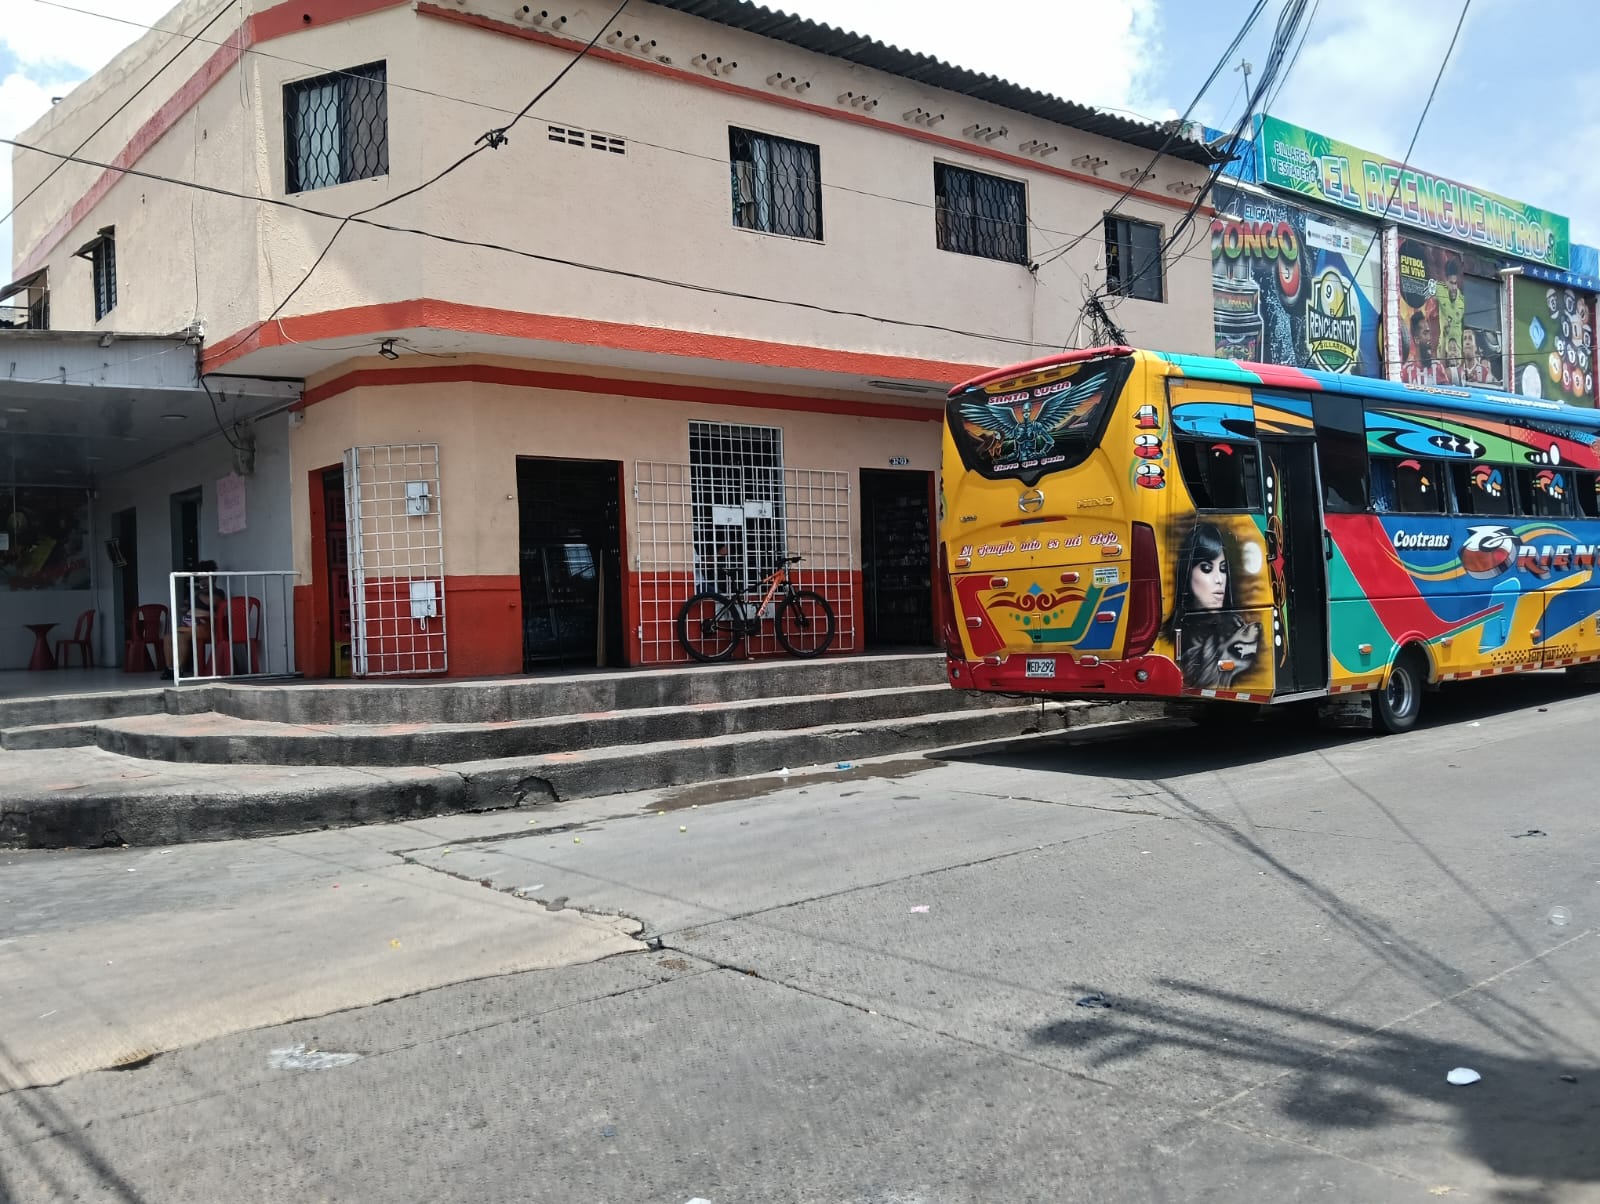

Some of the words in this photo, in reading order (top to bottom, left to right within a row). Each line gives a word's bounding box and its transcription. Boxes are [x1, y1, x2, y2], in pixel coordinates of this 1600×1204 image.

[1274, 140, 1310, 164] BILLARES
[1270, 157, 1276, 172] Y
[1277, 159, 1316, 183] ESTADERO
[1244, 203, 1254, 219] EL
[1255, 208, 1277, 223] GRAN
[1321, 154, 1361, 208] EL
[1362, 160, 1546, 260] REENCUENTRO
[1401, 255, 1424, 269] FUTBOL
[1401, 264, 1410, 275] EN
[1410, 266, 1426, 278] VIVO
[1325, 284, 1333, 299] 9
[1309, 310, 1356, 346] RENCUENTRO
[988, 391, 1029, 405] SANTA
[1034, 381, 1071, 396] LUCIA
[1076, 496, 1114, 508] HINO
[1393, 530, 1451, 548] Cootrans
